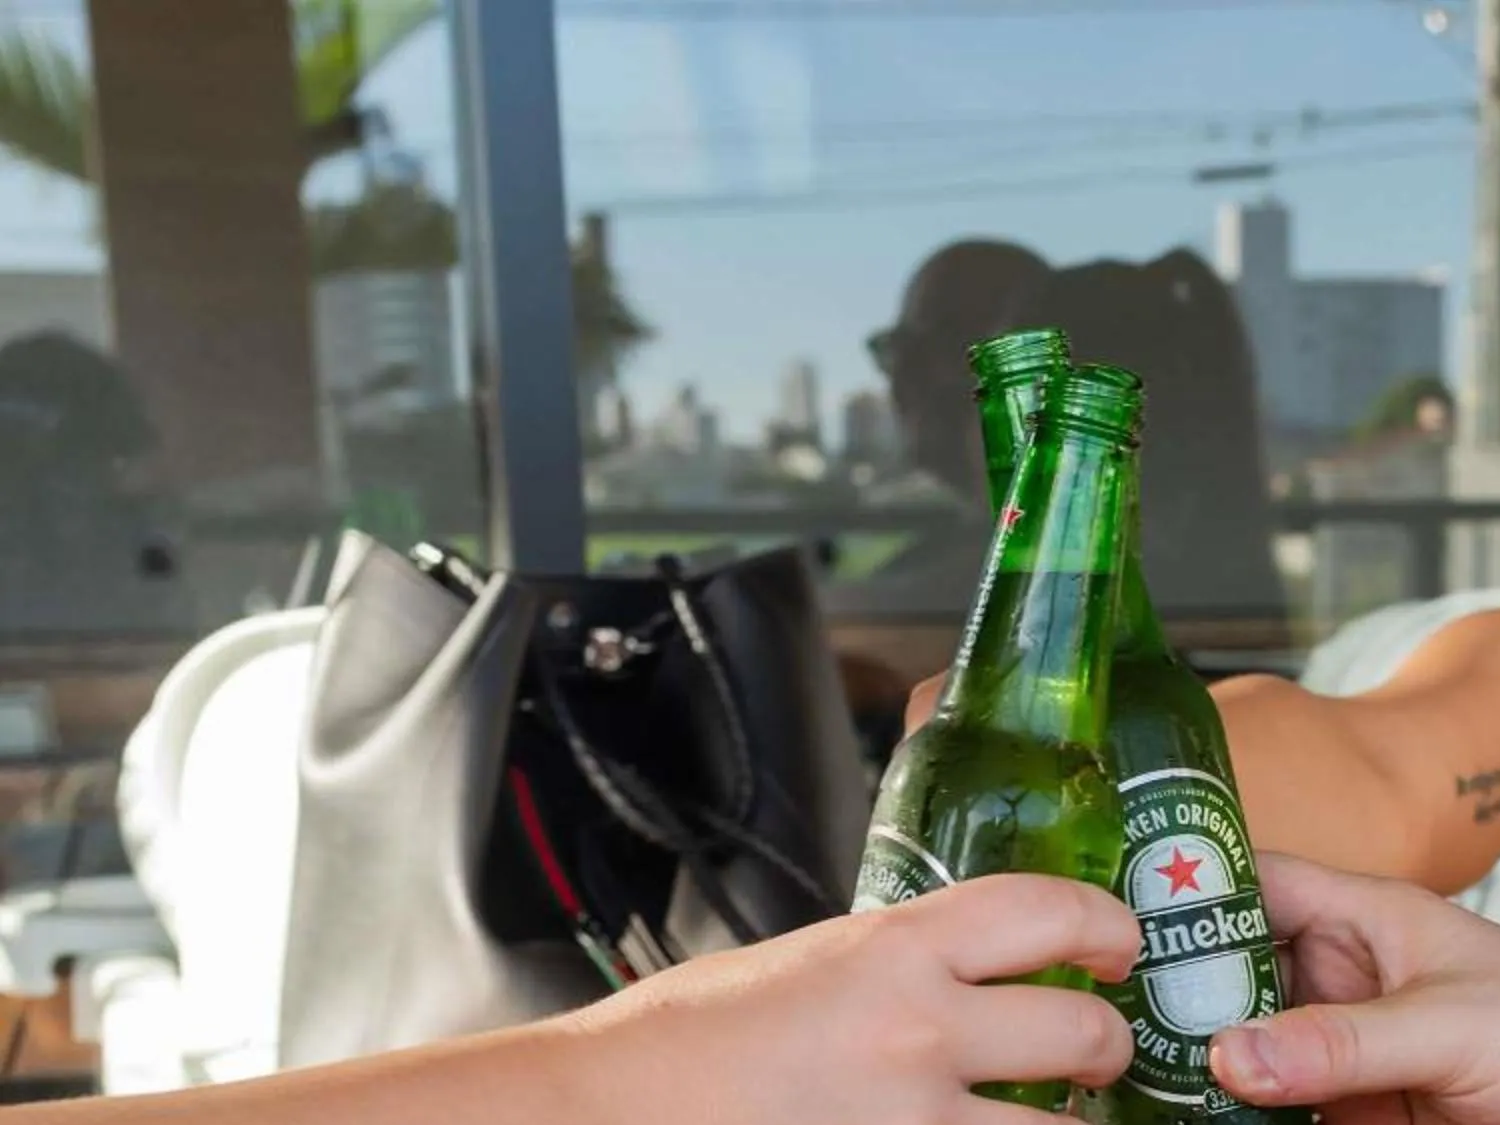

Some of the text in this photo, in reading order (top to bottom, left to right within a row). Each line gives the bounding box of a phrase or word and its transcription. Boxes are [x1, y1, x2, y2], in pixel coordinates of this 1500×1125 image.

[1175, 803, 1247, 873] ORIGINAL
[1137, 906, 1268, 962] ineken
[1131, 1017, 1181, 1065] PURE
